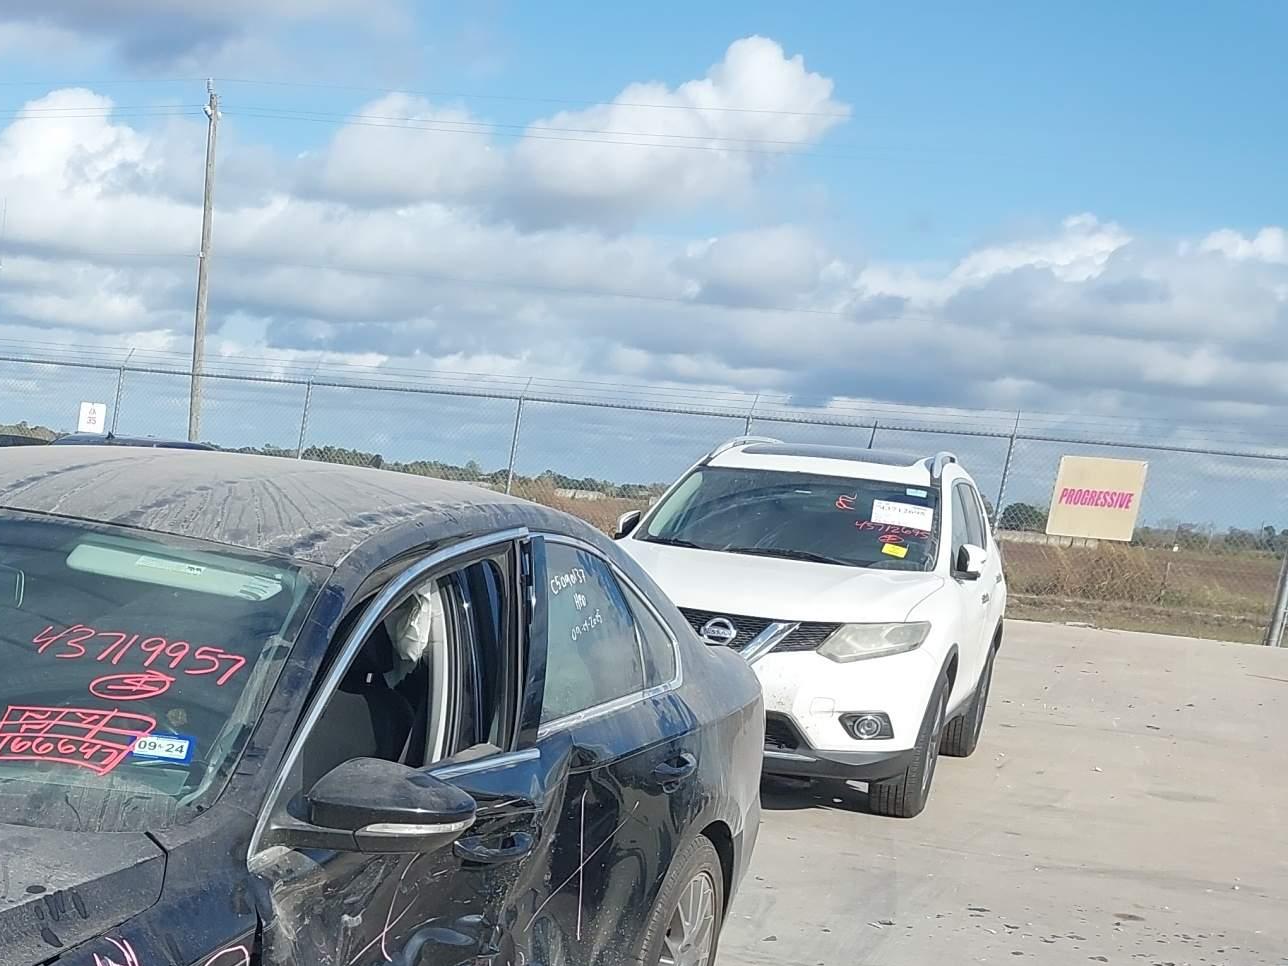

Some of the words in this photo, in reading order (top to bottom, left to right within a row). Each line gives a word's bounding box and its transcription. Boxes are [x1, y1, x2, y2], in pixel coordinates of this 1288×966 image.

[1058, 488, 1134, 509] PROGRESSIVE
[32, 624, 247, 686] 43719957
[137, 740, 158, 751] 09
[164, 743, 186, 754] 24
